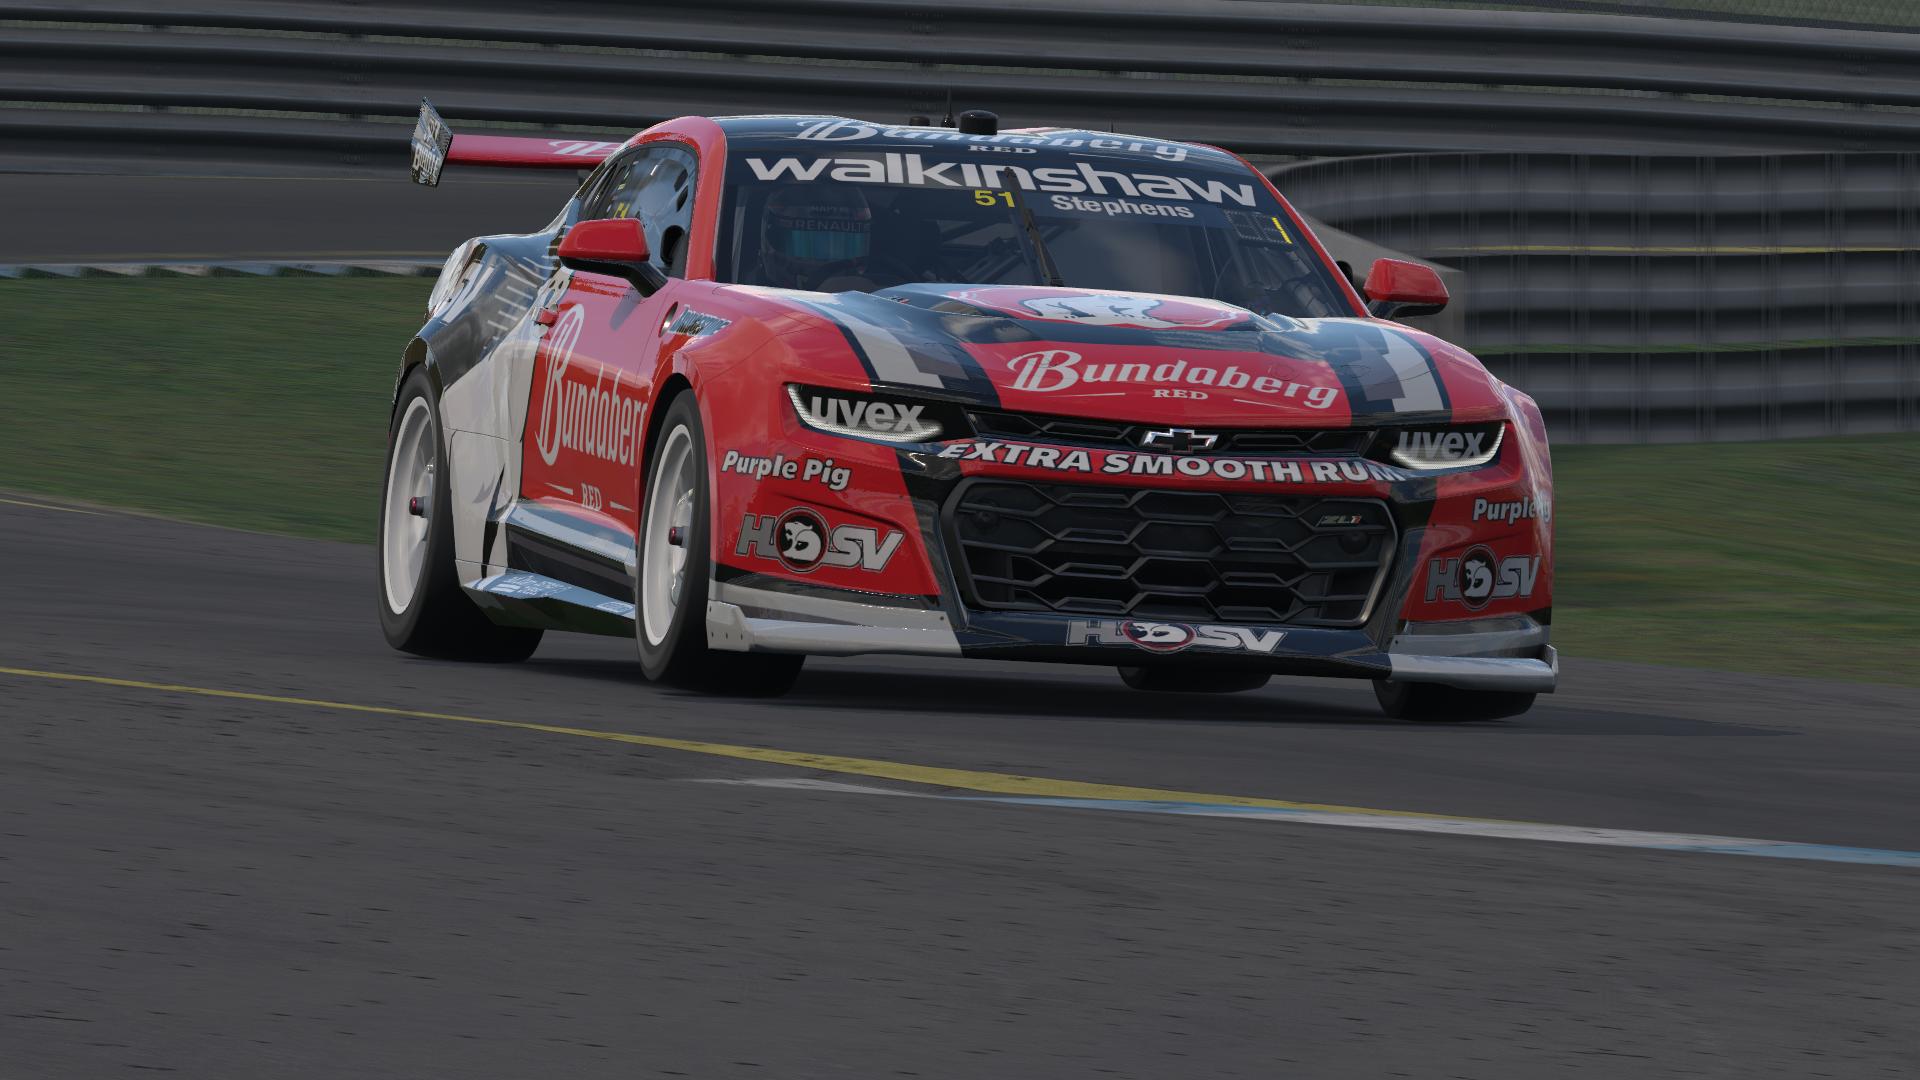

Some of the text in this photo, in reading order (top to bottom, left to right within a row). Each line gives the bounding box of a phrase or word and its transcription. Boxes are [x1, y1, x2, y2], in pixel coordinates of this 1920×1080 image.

[794, 119, 1189, 162] Bundaberg
[968, 145, 1038, 155] RED
[745, 153, 1256, 206] walkinshaw
[974, 190, 1016, 208] 51
[1052, 194, 1196, 219] Stephens
[1006, 349, 1339, 409] Bundaberg
[1152, 389, 1209, 400] RED
[810, 395, 926, 433] uvex
[1397, 431, 1487, 459] uvex
[721, 451, 852, 491] Purple Pig
[937, 441, 1407, 483] EXTRA SMOOTH RUM
[581, 482, 602, 512] RED
[1472, 496, 1536, 526] Purple
